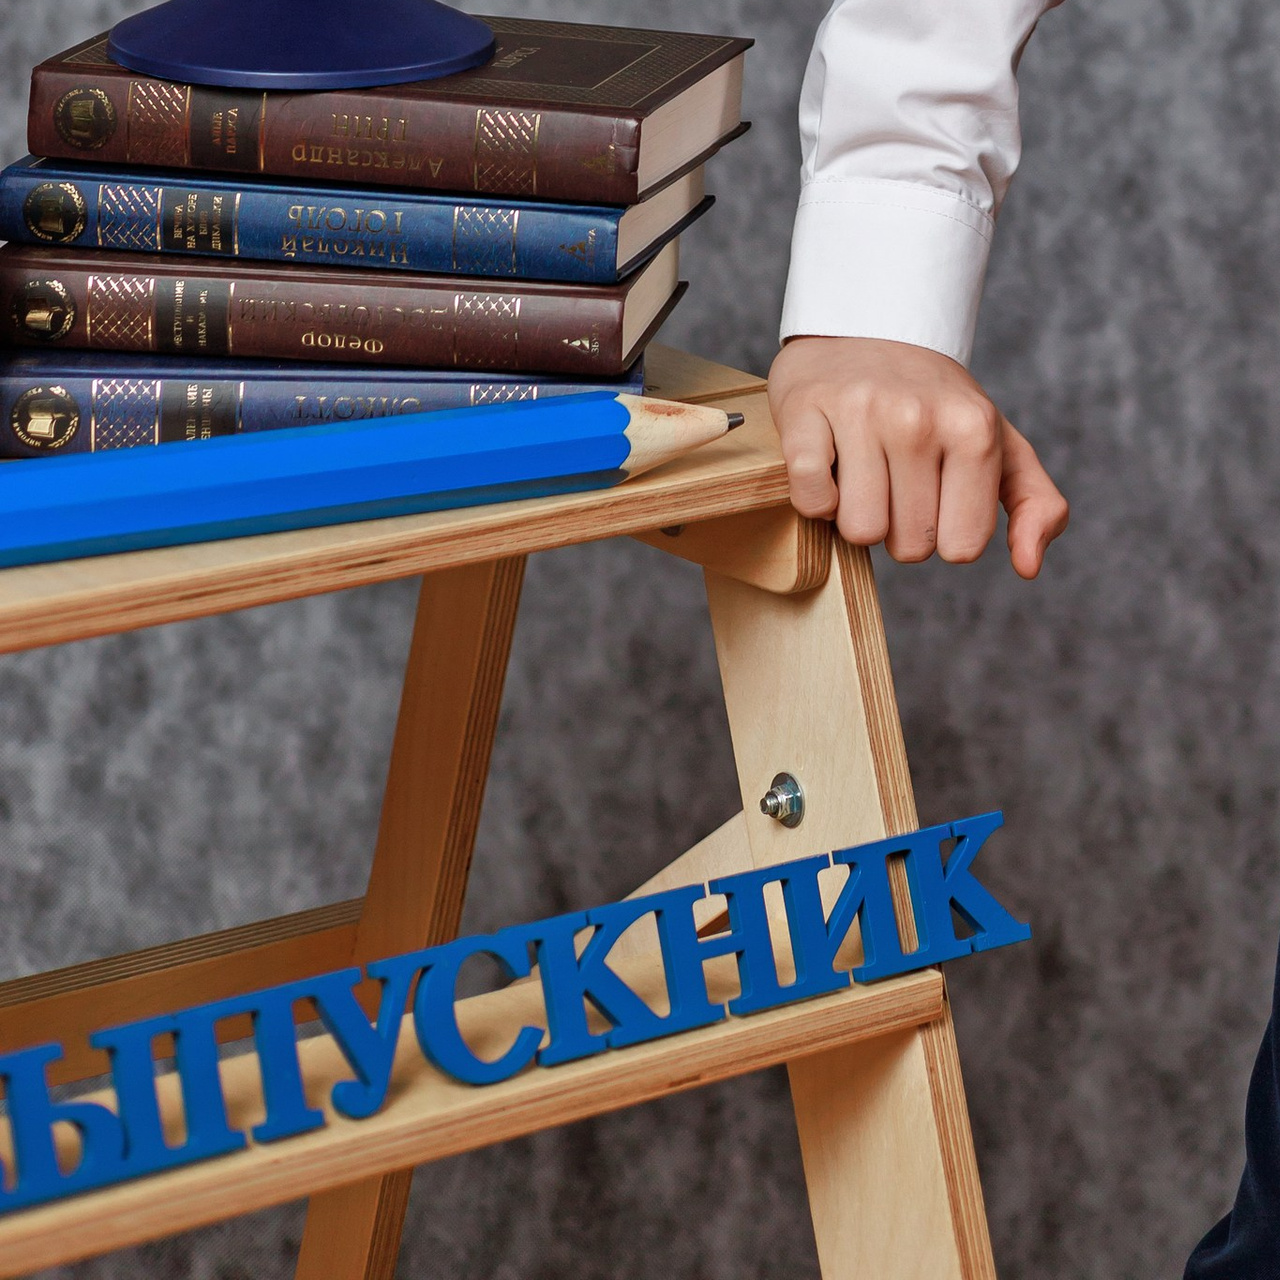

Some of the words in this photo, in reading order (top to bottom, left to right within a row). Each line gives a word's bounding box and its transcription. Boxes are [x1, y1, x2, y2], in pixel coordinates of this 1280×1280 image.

[227, 107, 239, 154] ПАРУСА
[331, 113, 409, 142] ГРИН
[292, 143, 444, 178] Александр
[288, 205, 404, 234] ГОГОЛЬ
[187, 234, 196, 249] НА
[281, 235, 409, 264] Николай
[239, 298, 448, 329] ДОСТОЕВСКИЙ
[301, 332, 384, 354] Федор
[0, 811, 1031, 1215] ЫПУСКНИК
